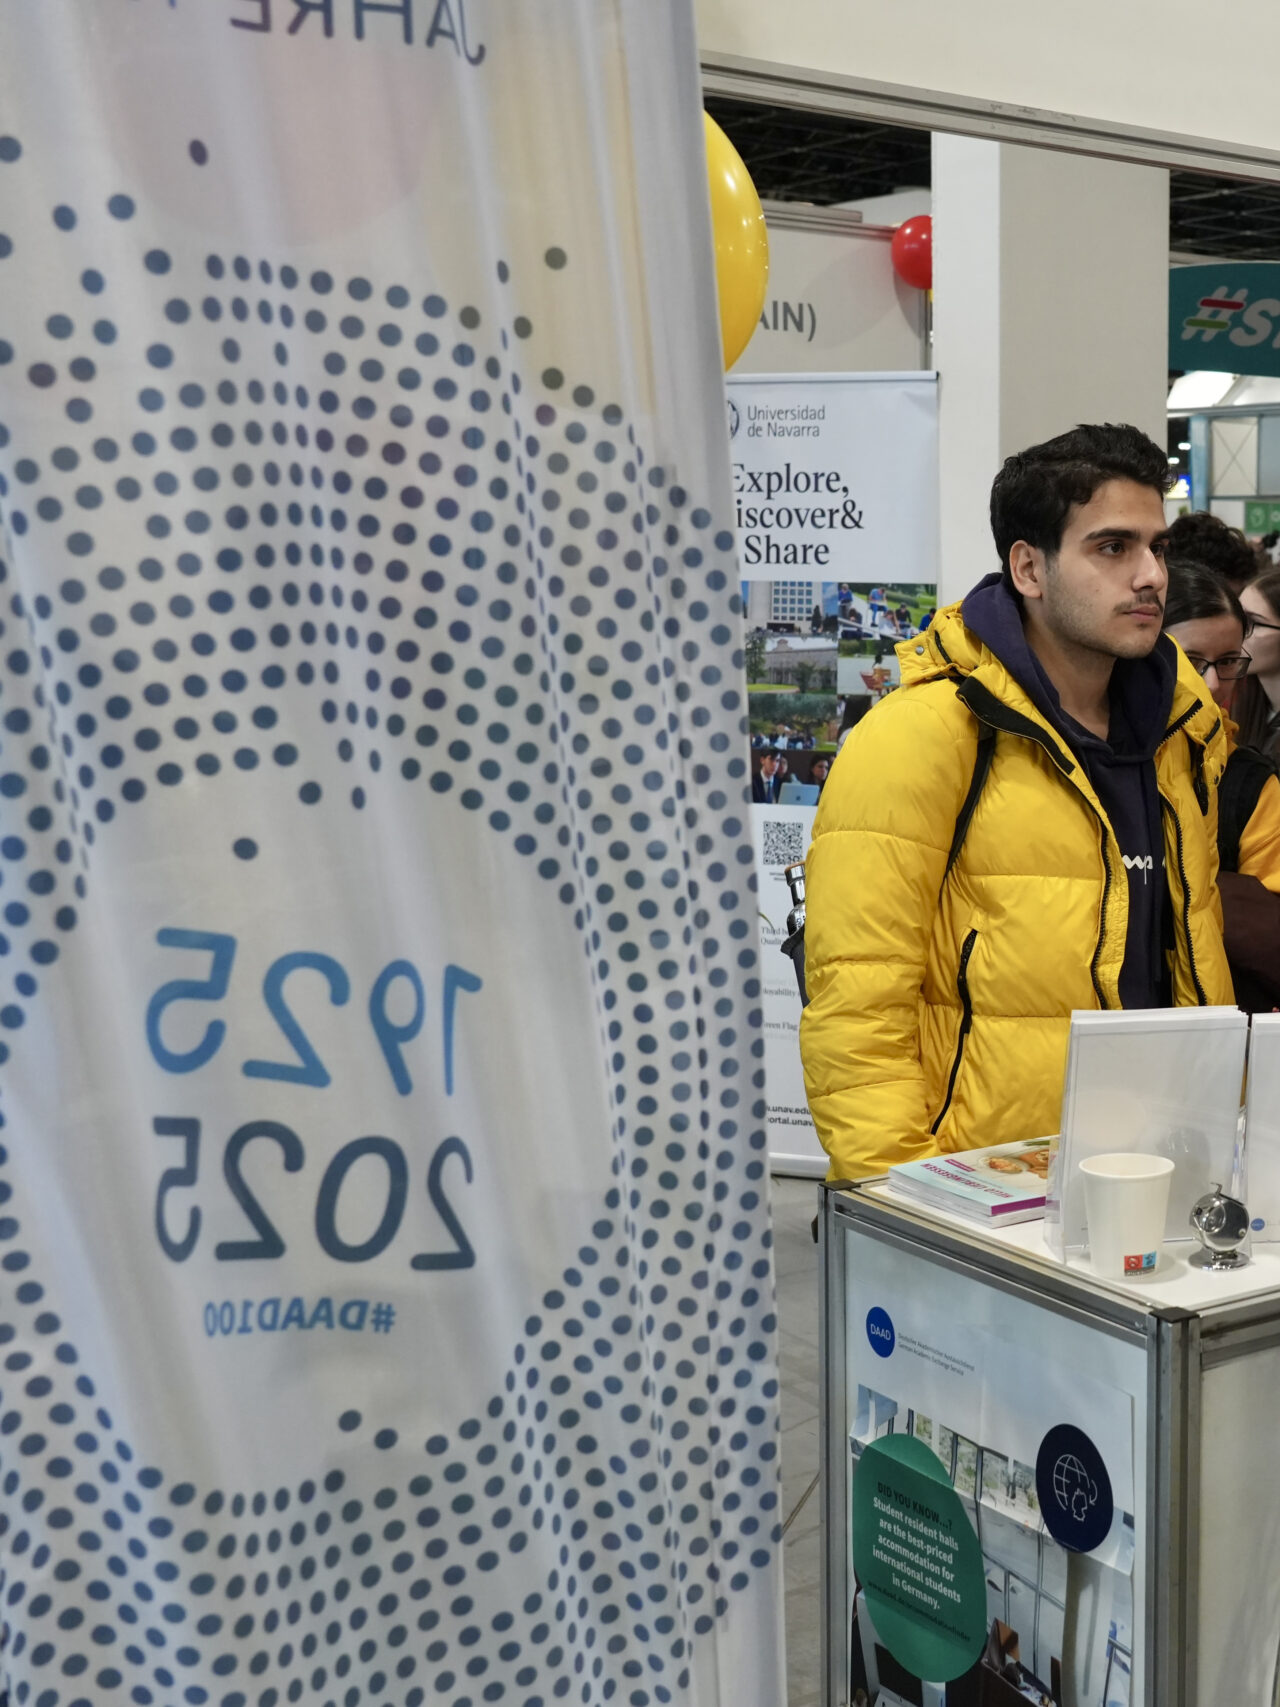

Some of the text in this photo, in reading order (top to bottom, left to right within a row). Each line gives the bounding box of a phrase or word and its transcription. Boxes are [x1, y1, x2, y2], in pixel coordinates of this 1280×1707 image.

[759, 300, 816, 342] AIN)
[747, 405, 826, 421] Universidad
[747, 421, 820, 438] de Navarra
[732, 463, 849, 500] Explore,
[736, 499, 864, 529] iscover&
[744, 534, 830, 565] Share
[870, 1323, 891, 1341] DAAD
[877, 1482, 892, 1498] DID
[893, 1490, 911, 1509] YOU
[873, 1496, 959, 1551] Student resident halls
[880, 1518, 953, 1565] are the best-priced
[873, 1544, 961, 1603] international students
[878, 1534, 955, 1582] accommodation for
[892, 1572, 940, 1609] in Germany.
